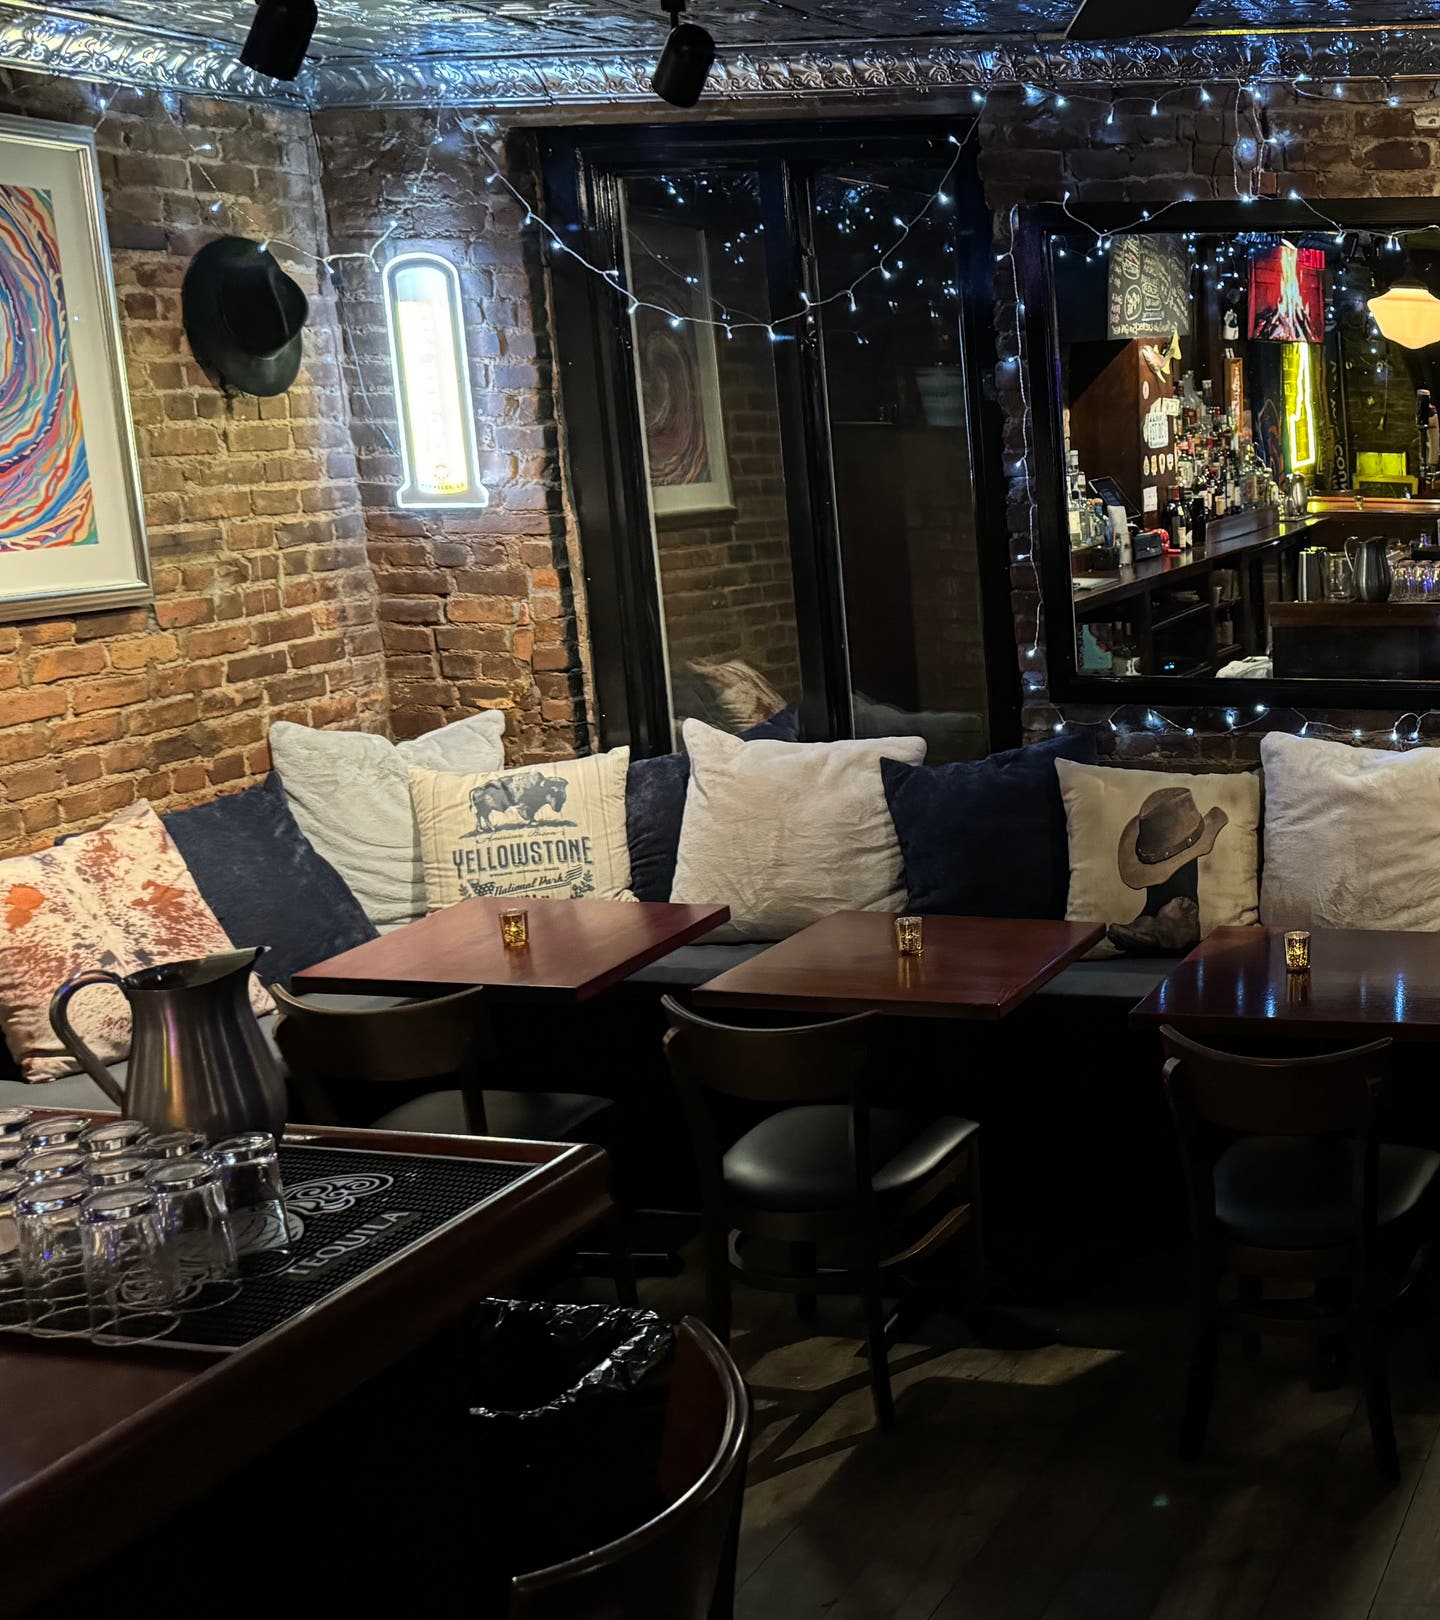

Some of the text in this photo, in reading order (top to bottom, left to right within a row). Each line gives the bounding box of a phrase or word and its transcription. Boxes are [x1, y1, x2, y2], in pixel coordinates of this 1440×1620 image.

[452, 836, 593, 880] YELLOWSTONE
[494, 873, 563, 896] National Park
[284, 1210, 410, 1275] TEQUILA
